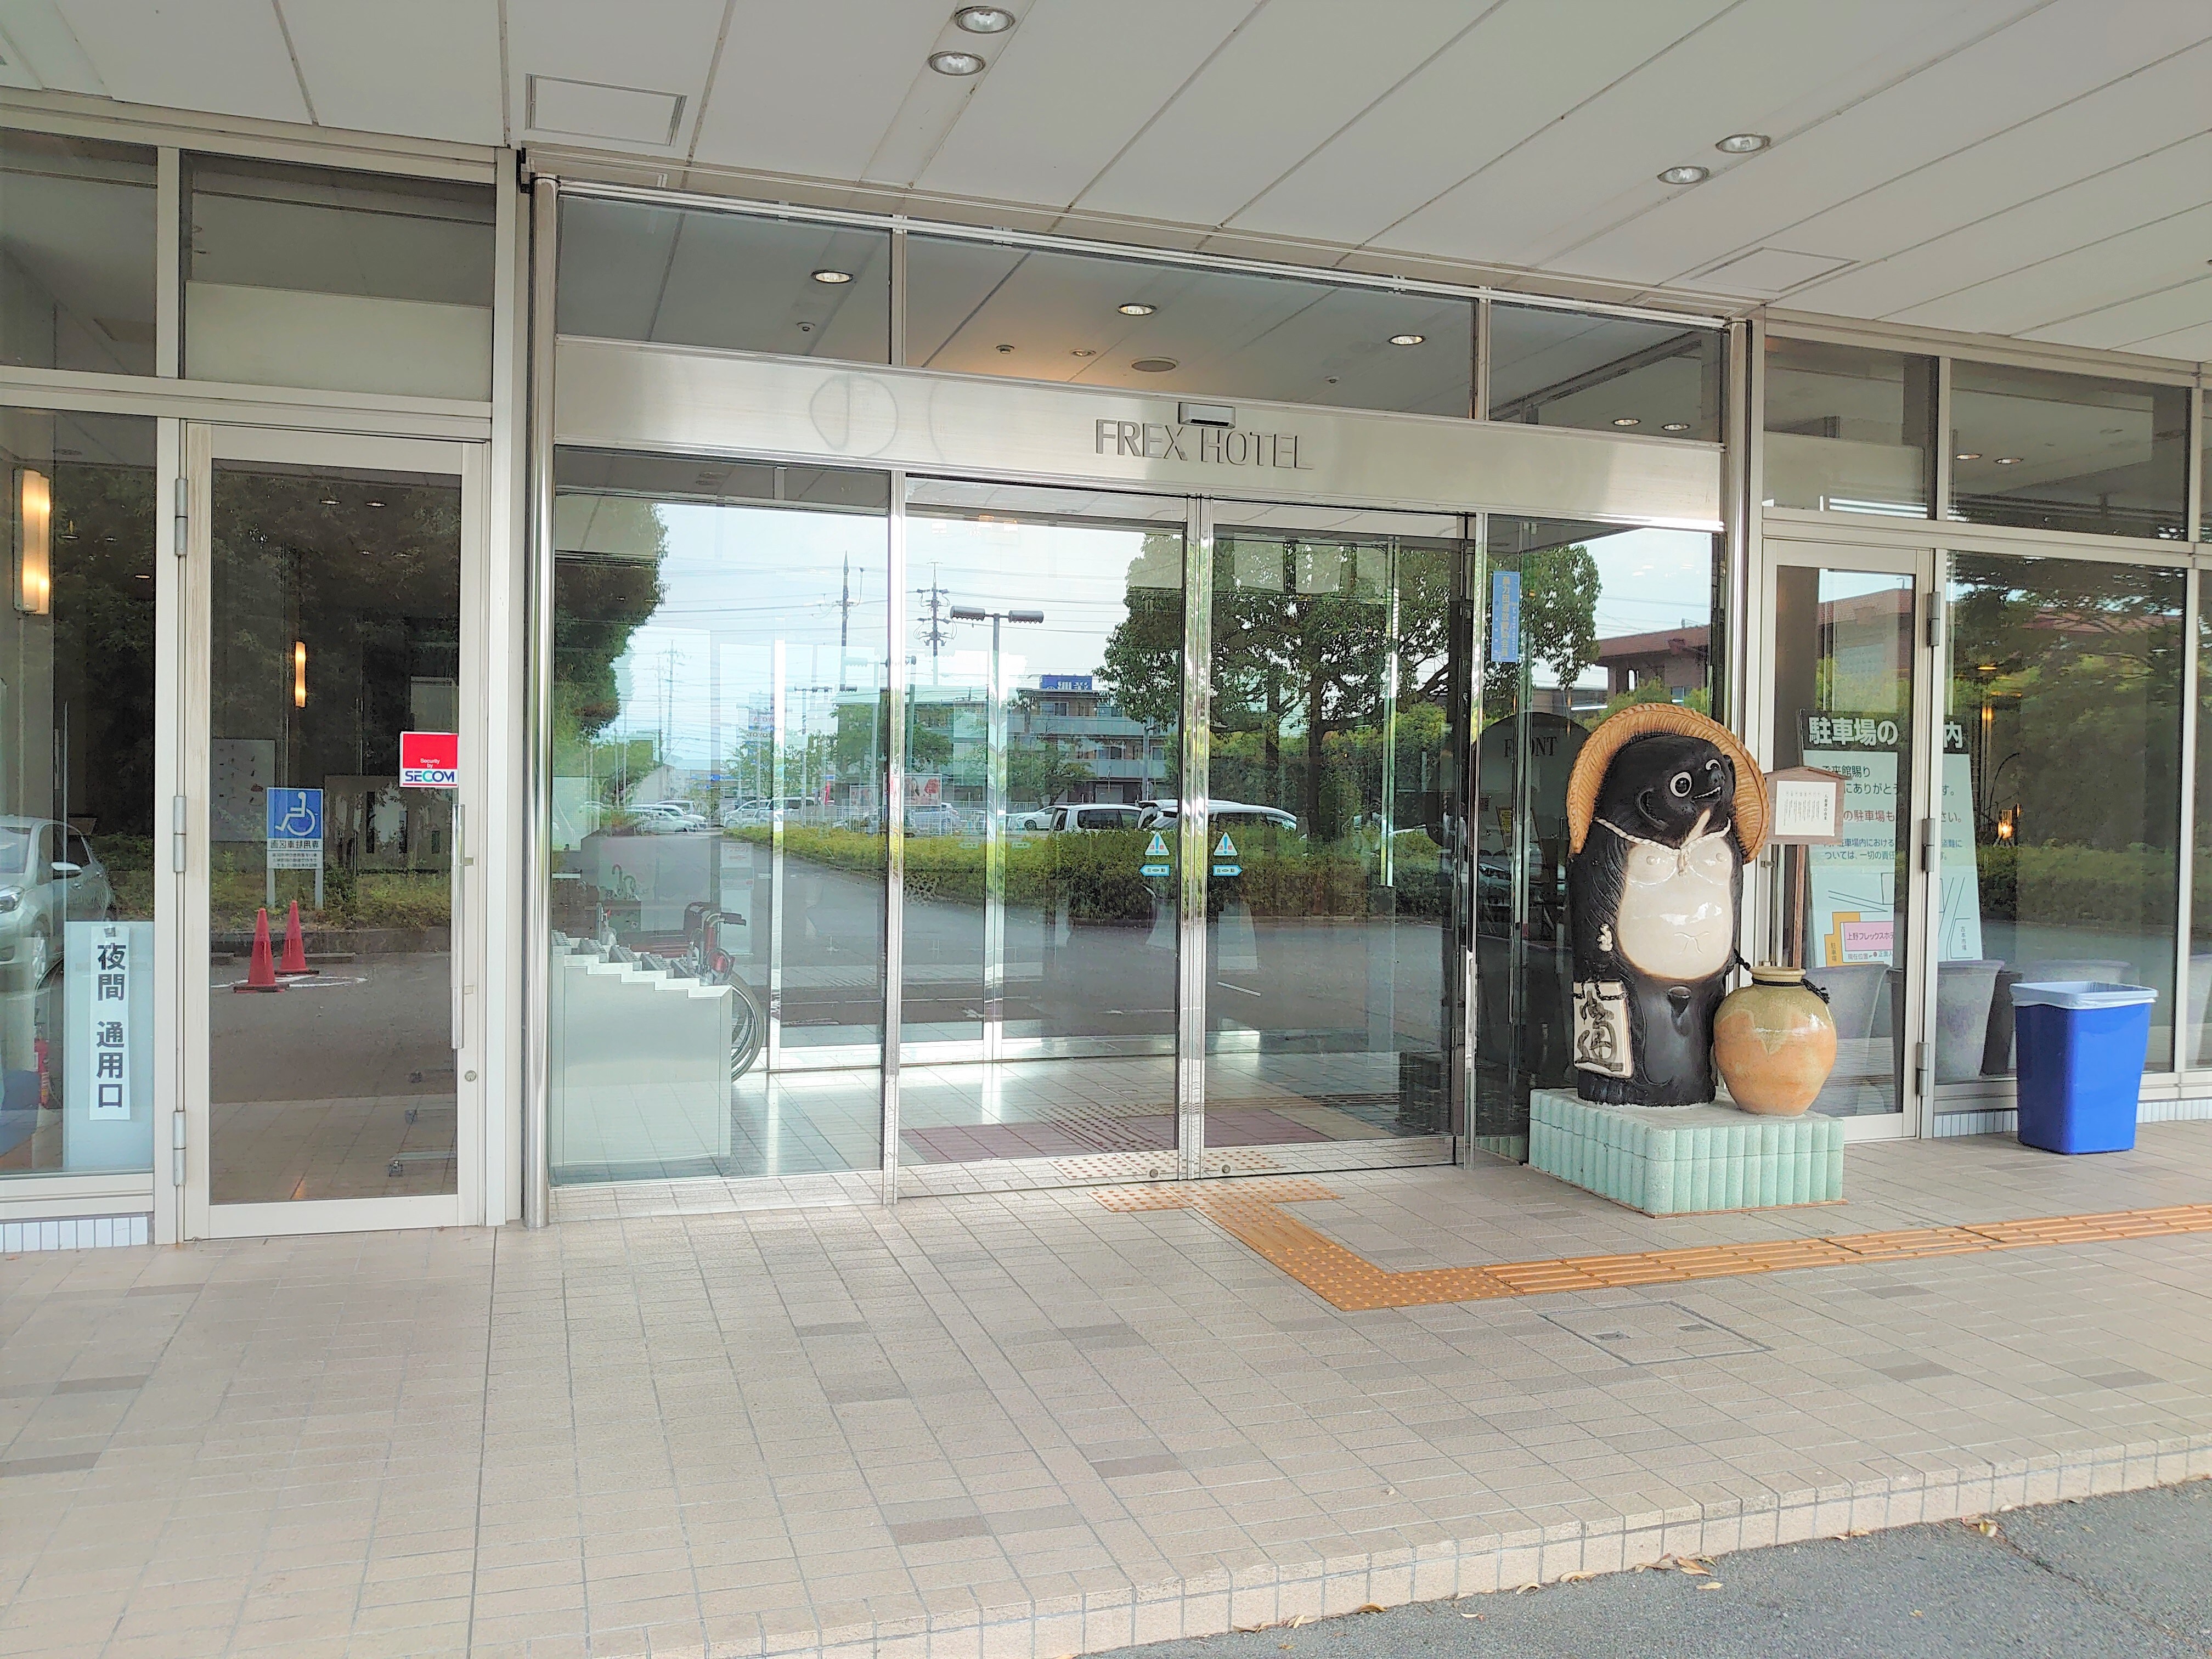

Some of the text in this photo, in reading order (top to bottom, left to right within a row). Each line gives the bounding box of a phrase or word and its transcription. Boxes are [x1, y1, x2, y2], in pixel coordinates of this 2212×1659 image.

[1096, 419, 1315, 470] FREX HOTEL
[405, 770, 455, 782] SECOM
